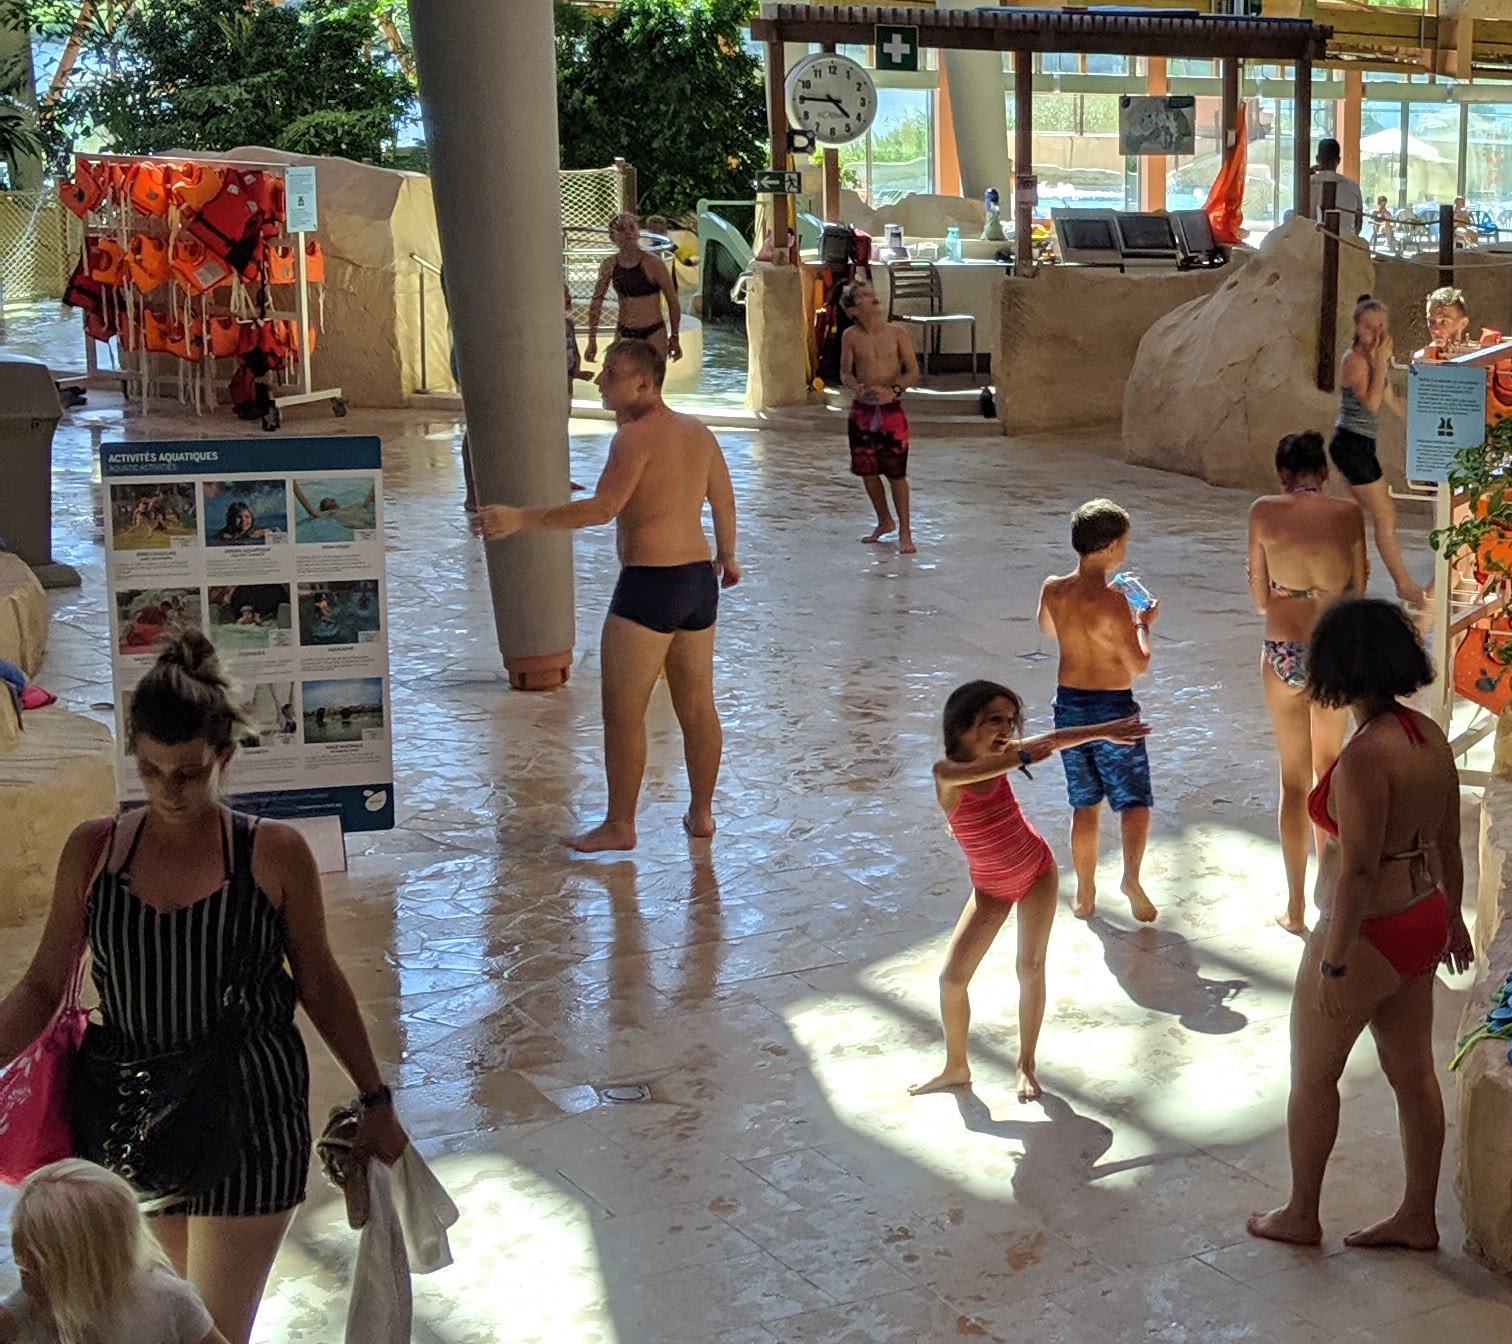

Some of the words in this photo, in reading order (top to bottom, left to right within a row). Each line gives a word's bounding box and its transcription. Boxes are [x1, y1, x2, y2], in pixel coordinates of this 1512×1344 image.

[814, 69, 822, 79] 11
[828, 65, 837, 75] 12
[801, 80, 811, 89] 10
[856, 82, 862, 91] 2
[860, 97, 866, 107] 3
[804, 110, 809, 120] 8
[830, 127, 836, 136] 6
[845, 123, 851, 133] 5
[108, 451, 157, 463] ACTIVITÉS
[159, 451, 219, 463] AQUATIQUES
